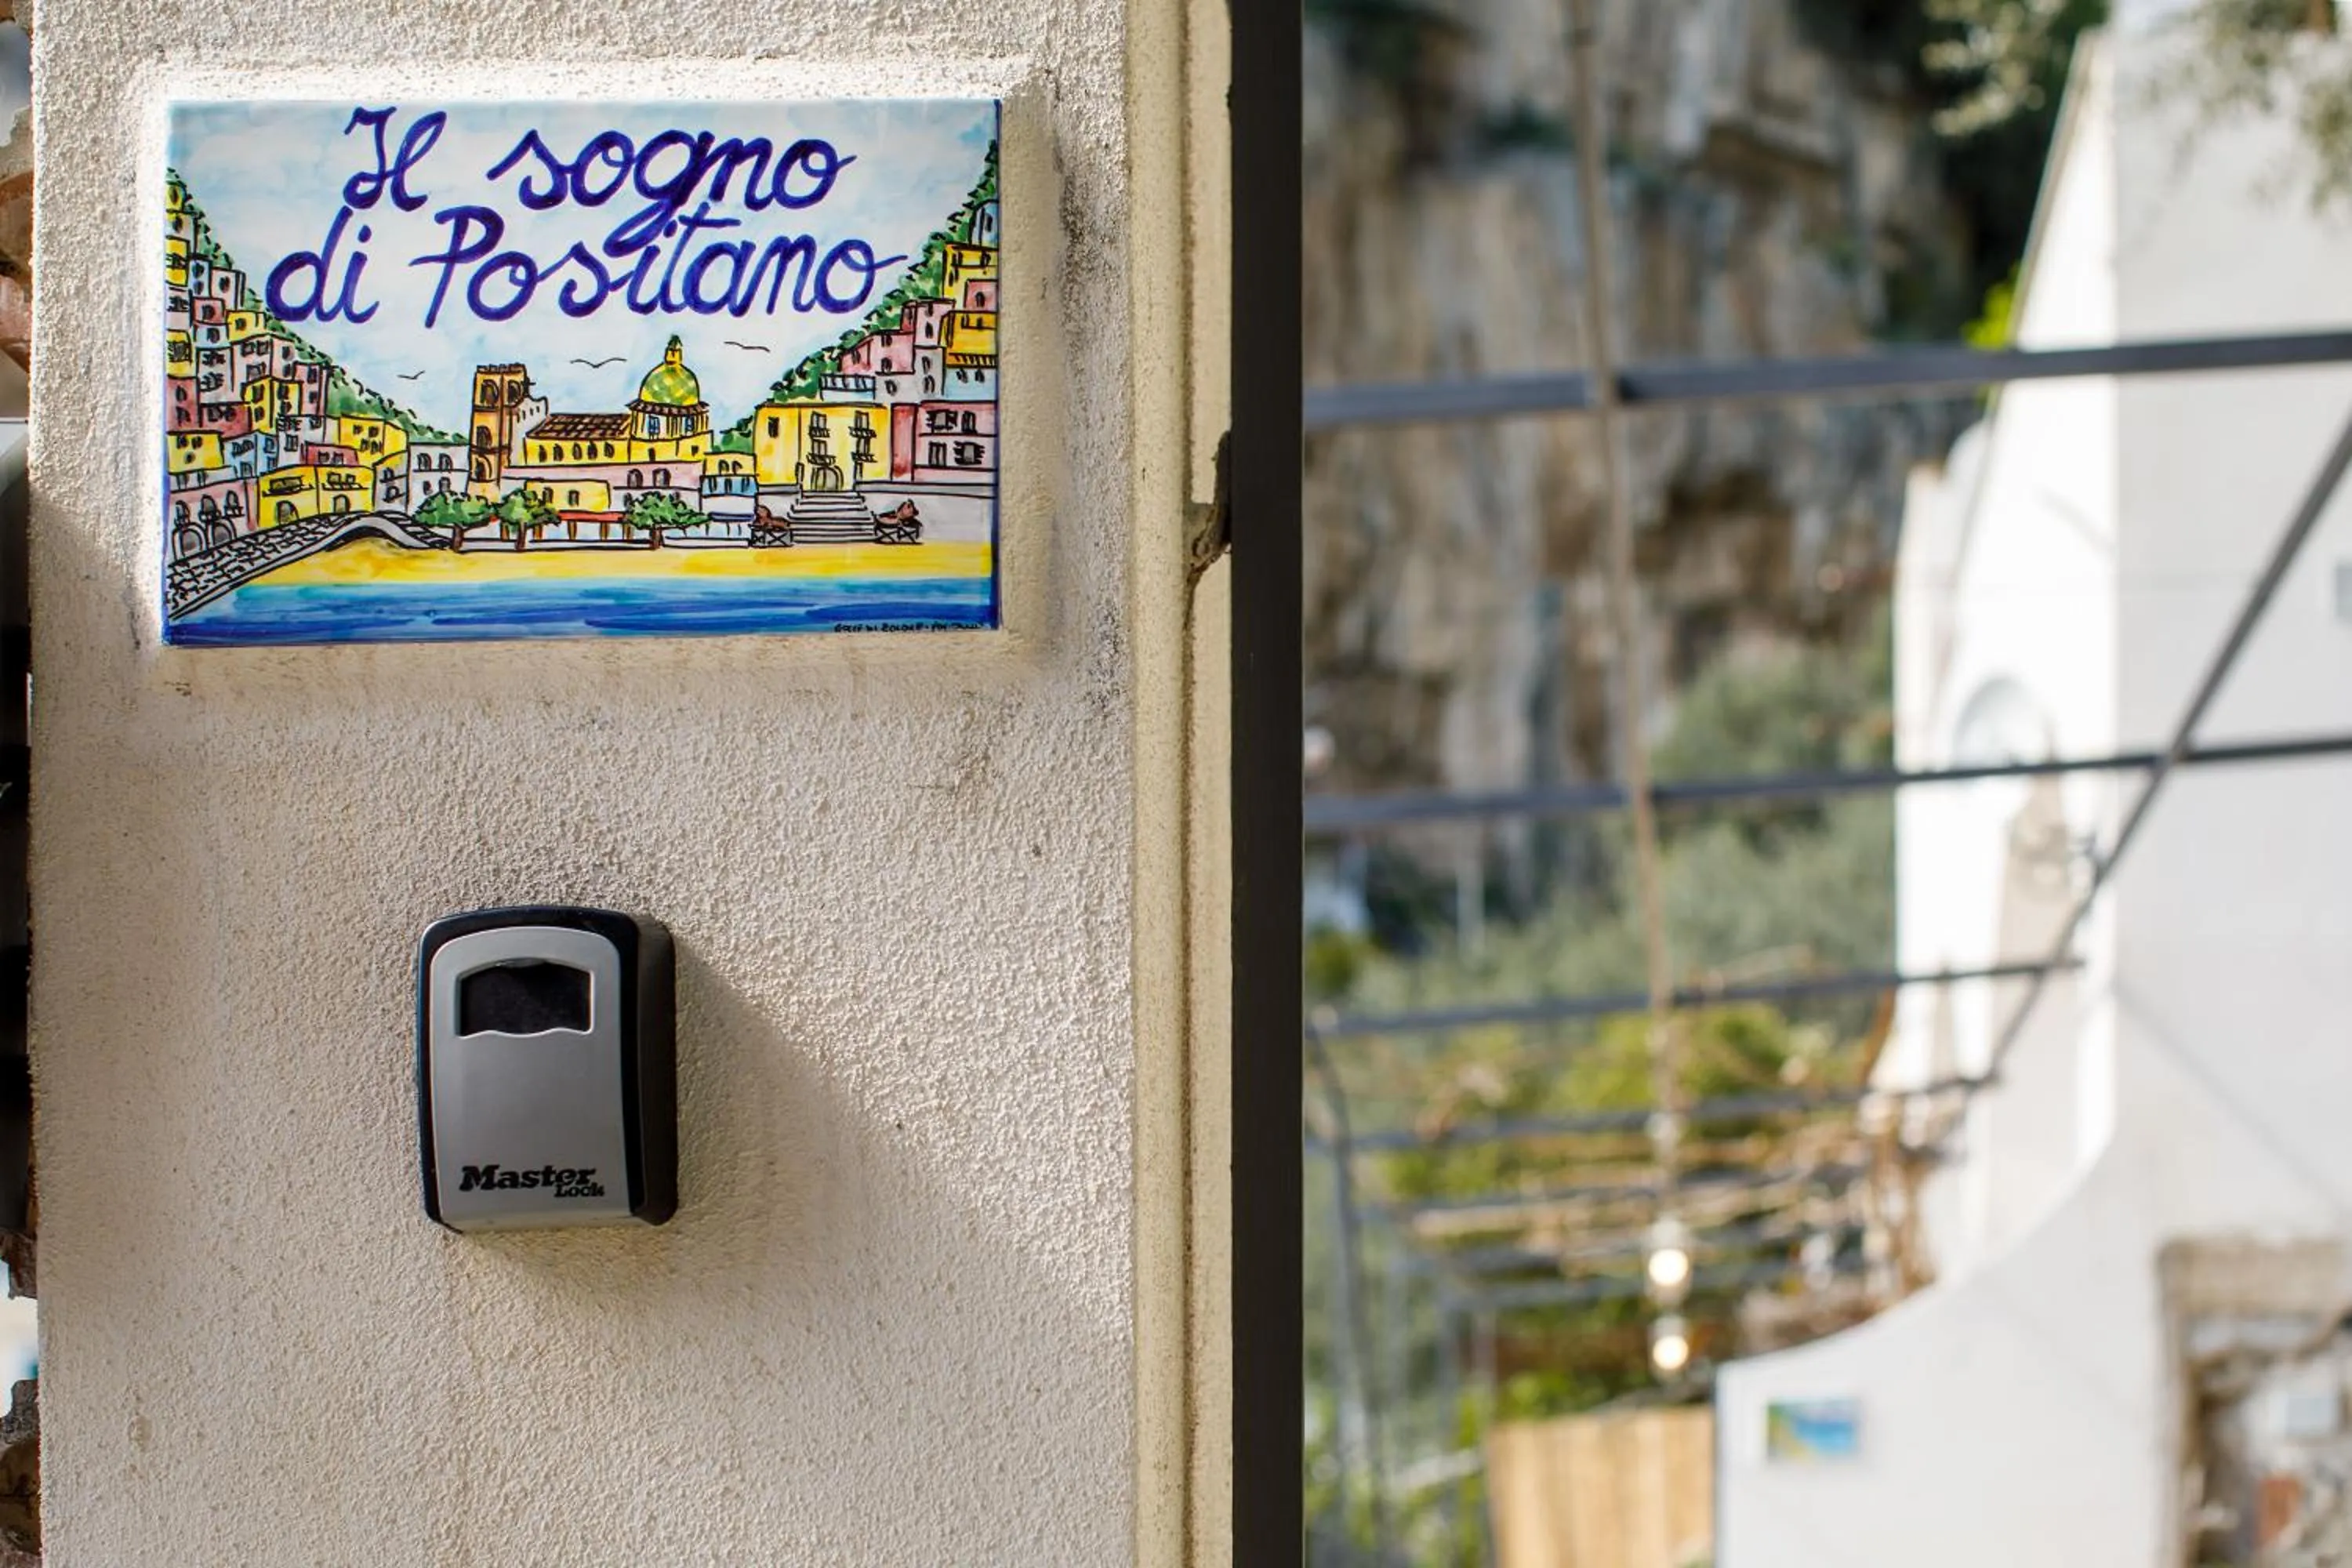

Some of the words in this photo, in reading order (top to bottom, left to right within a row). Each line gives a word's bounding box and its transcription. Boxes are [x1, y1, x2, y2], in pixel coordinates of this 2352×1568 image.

[343, 106, 447, 211] Il
[486, 129, 858, 257] sogno
[265, 205, 379, 323] di
[409, 201, 908, 328] Positano
[459, 1164, 597, 1192] Master
[554, 1182, 605, 1198] Lock
